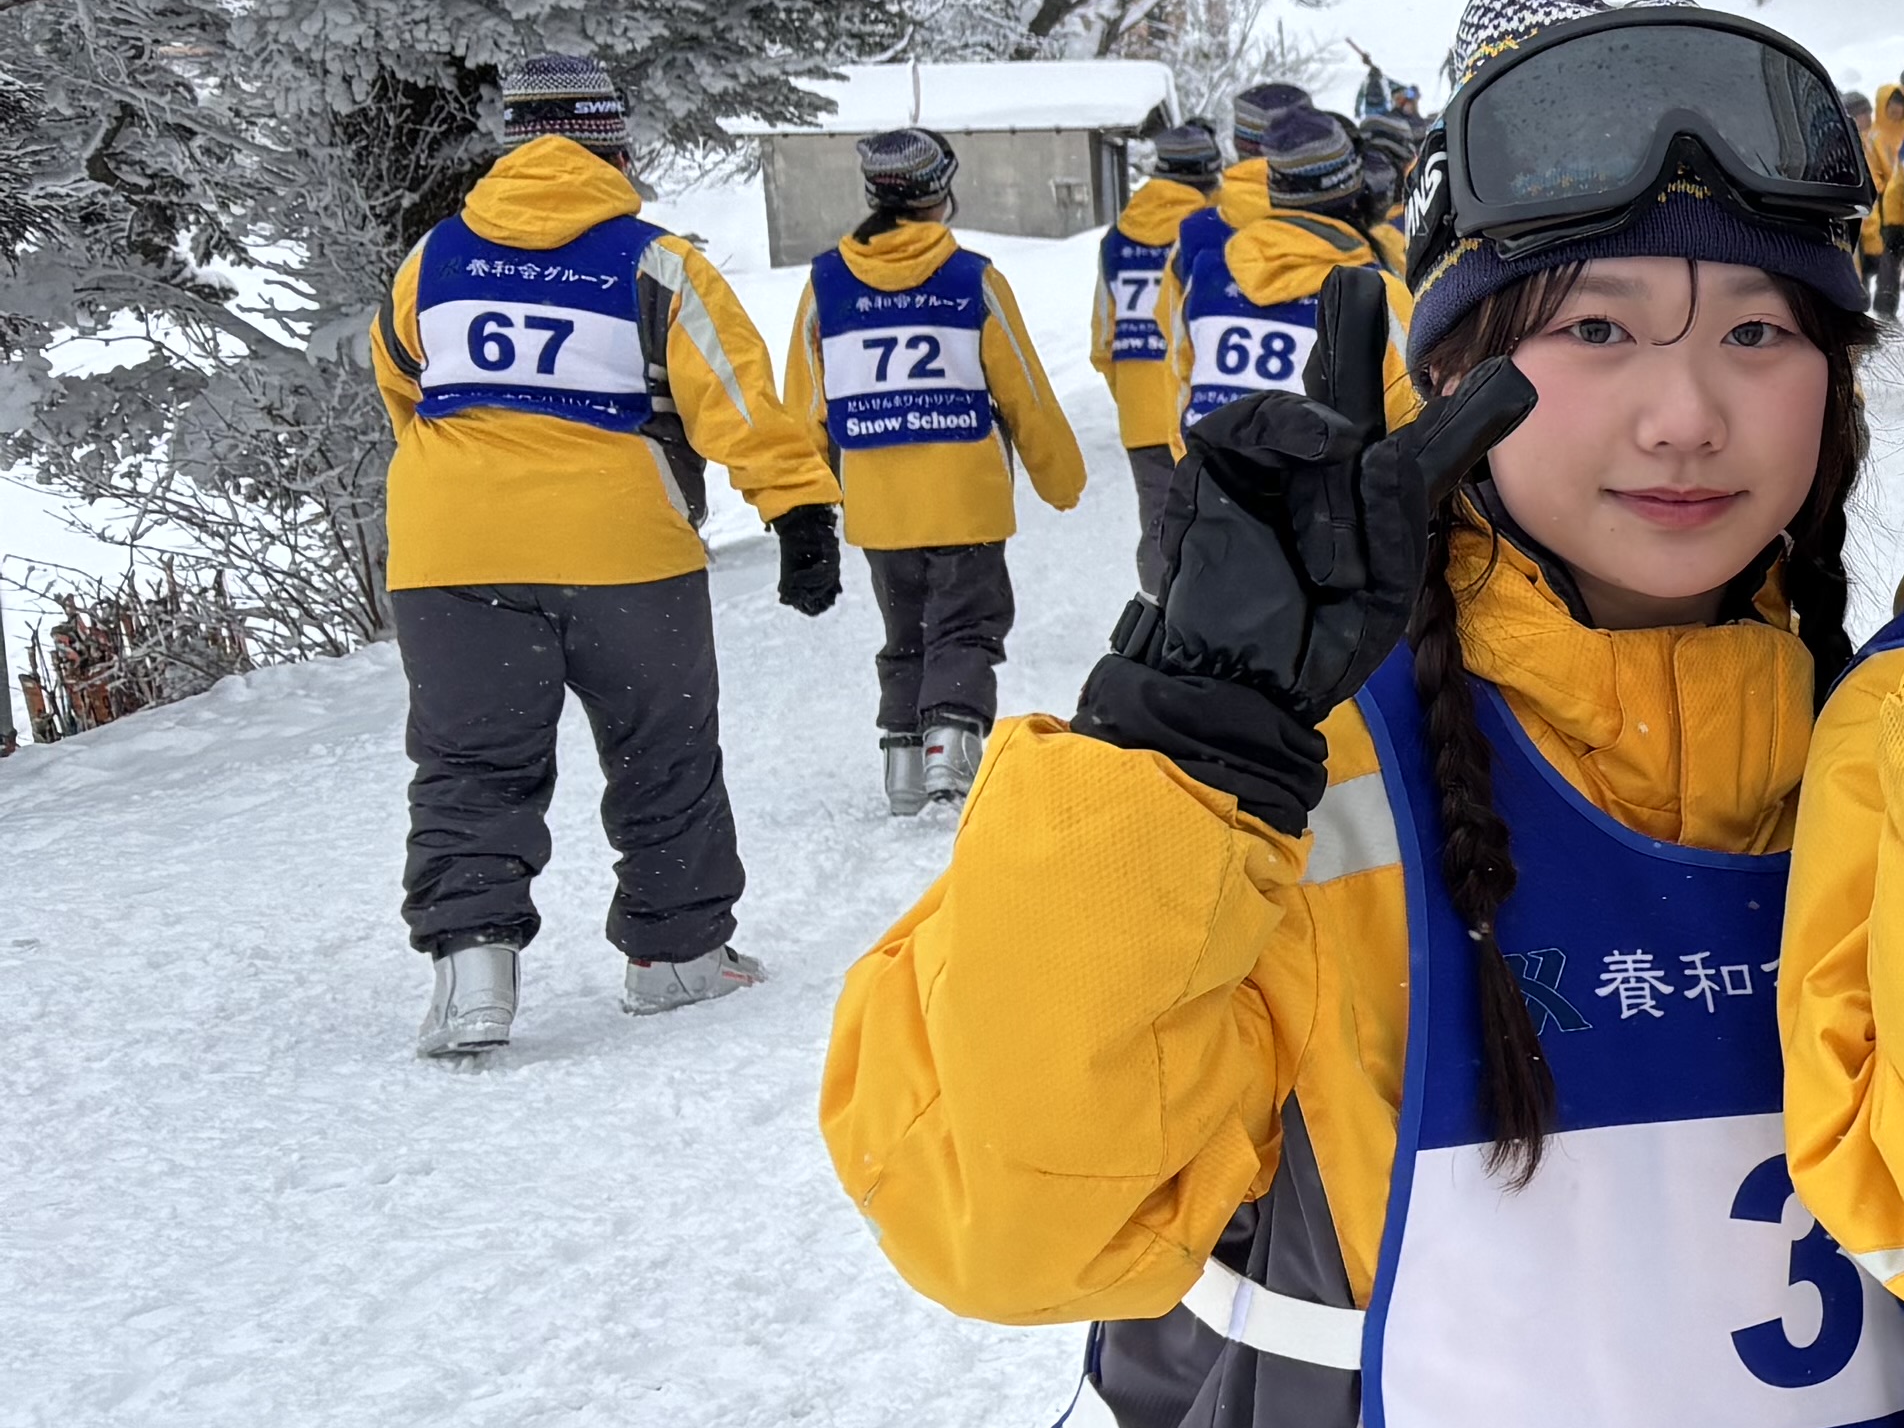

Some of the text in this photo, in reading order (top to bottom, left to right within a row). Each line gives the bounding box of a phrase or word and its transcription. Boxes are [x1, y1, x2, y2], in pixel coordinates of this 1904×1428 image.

[1121, 277, 1162, 312] 7
[467, 311, 575, 376] 67
[862, 334, 946, 383] 72
[1216, 326, 1297, 381] 68
[846, 410, 978, 437] Snow School
[1594, 948, 1780, 1019] 養和
[1729, 1152, 1864, 1389] 3
